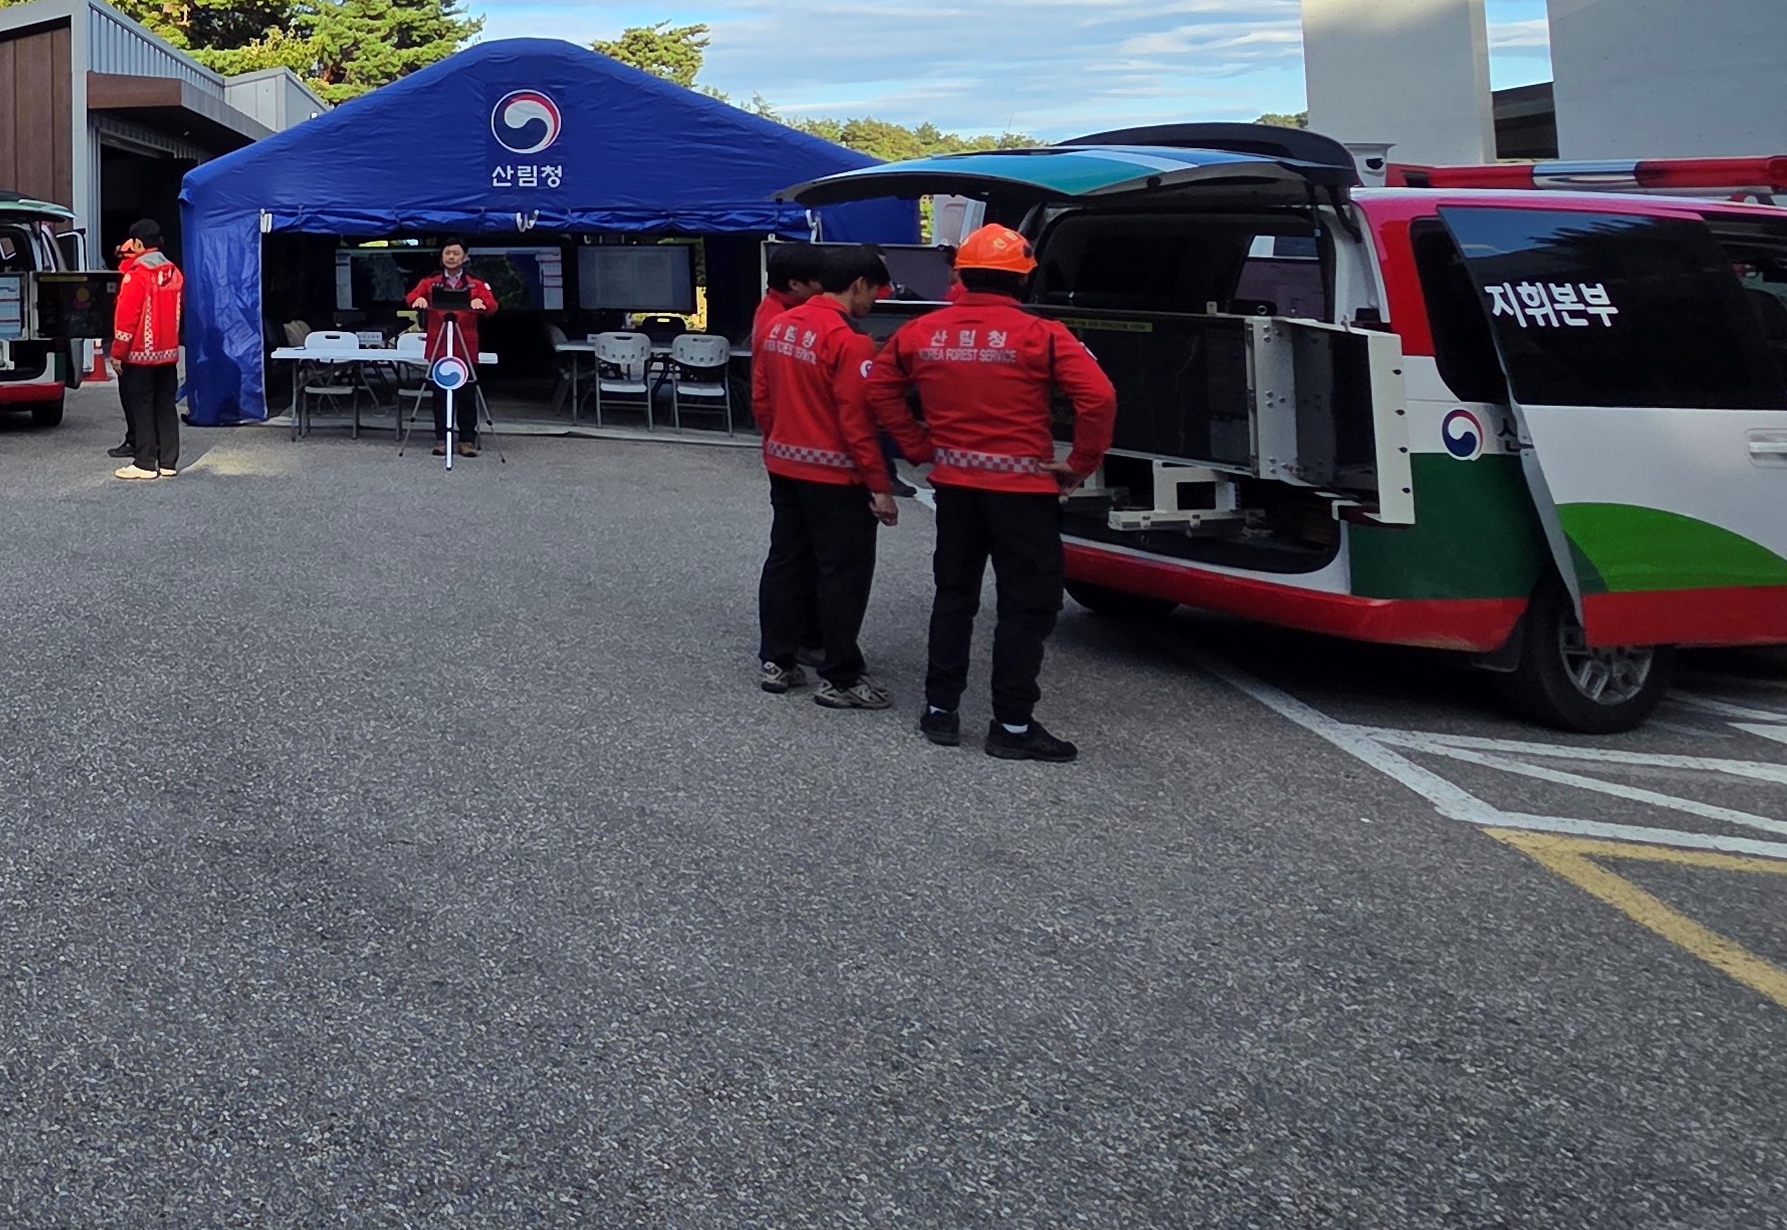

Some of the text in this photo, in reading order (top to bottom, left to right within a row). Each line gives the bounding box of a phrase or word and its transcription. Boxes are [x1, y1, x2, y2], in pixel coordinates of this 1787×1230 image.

[492, 164, 563, 188] 산림청
[1484, 281, 1619, 327] 지휘본부
[945, 348, 978, 361] FOREST
[979, 349, 1017, 363] SERVICE
